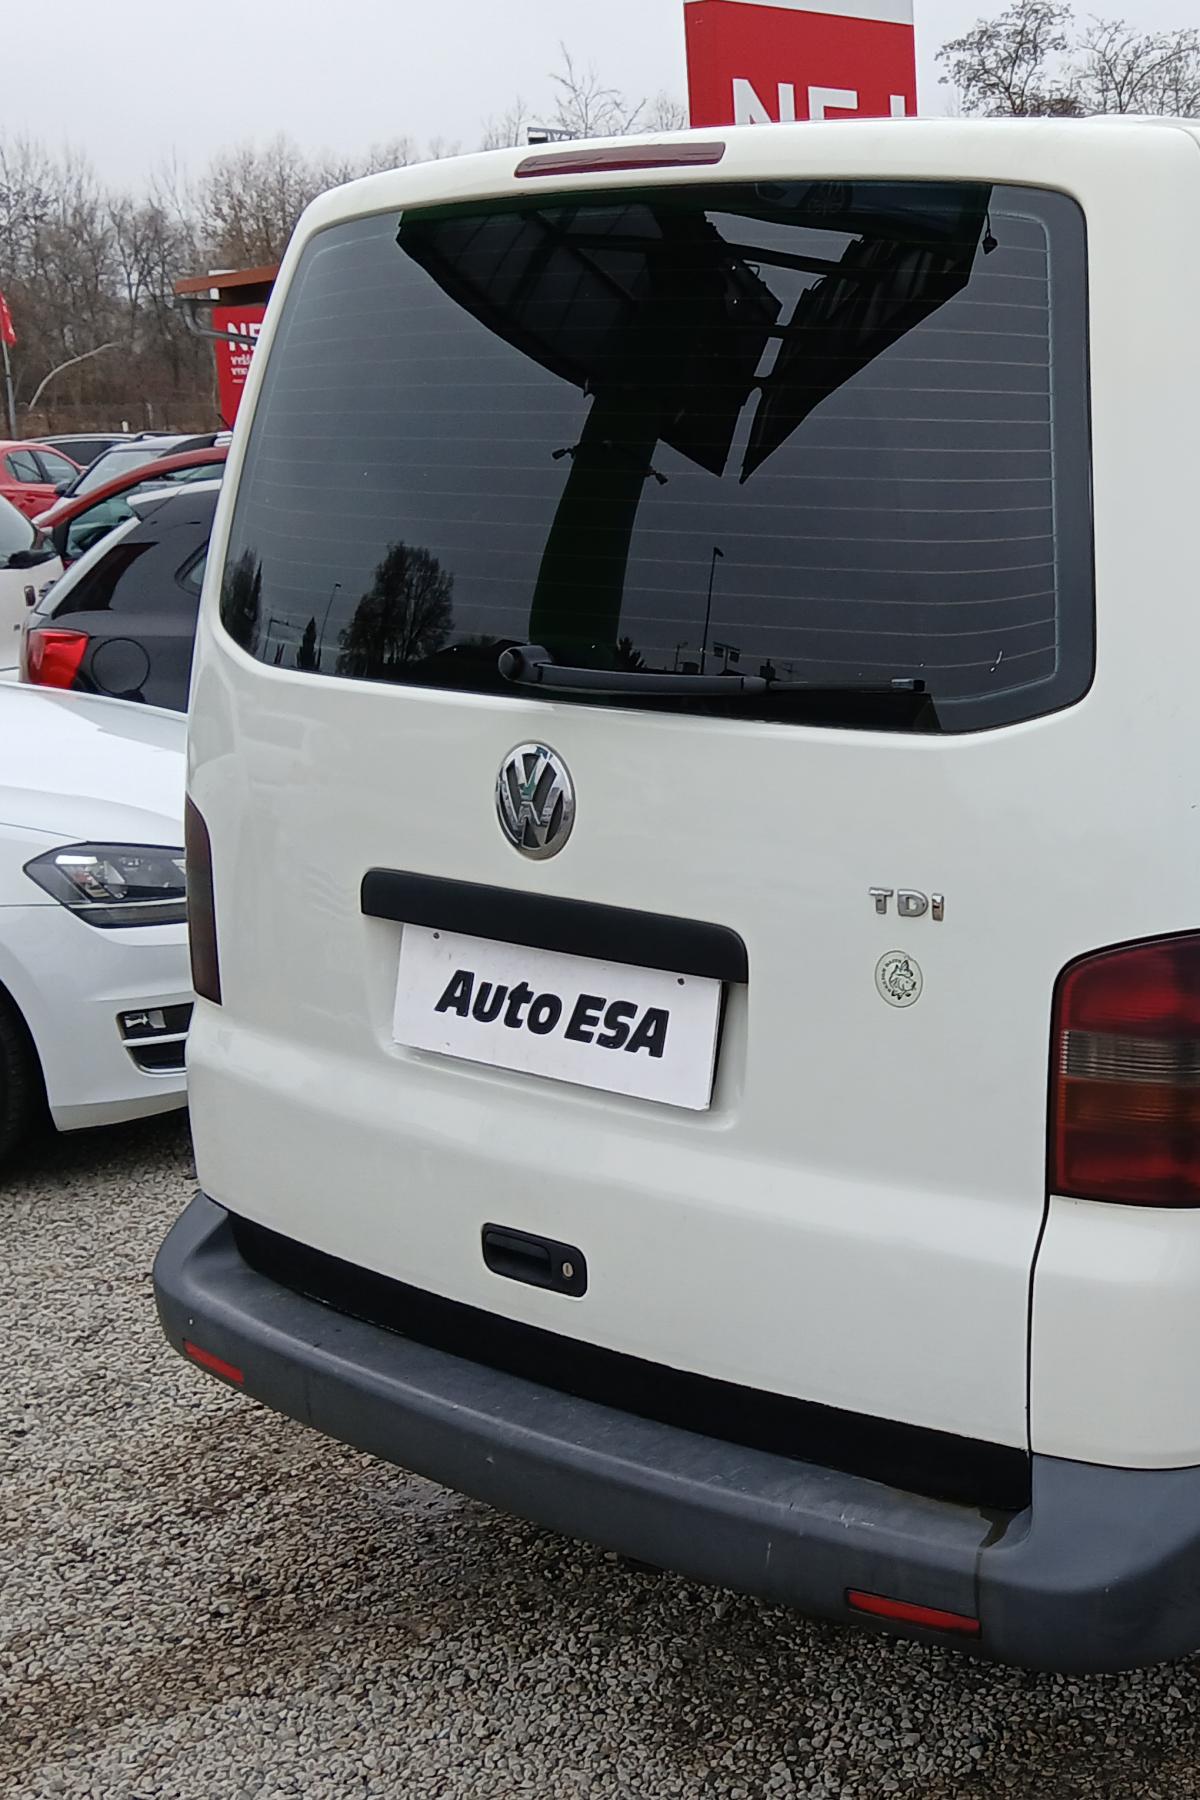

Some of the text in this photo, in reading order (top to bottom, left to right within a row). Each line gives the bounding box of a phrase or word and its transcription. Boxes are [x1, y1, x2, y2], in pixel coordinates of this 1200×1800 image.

[869, 886, 945, 922] TDI
[434, 969, 670, 1058] Auto ESA
